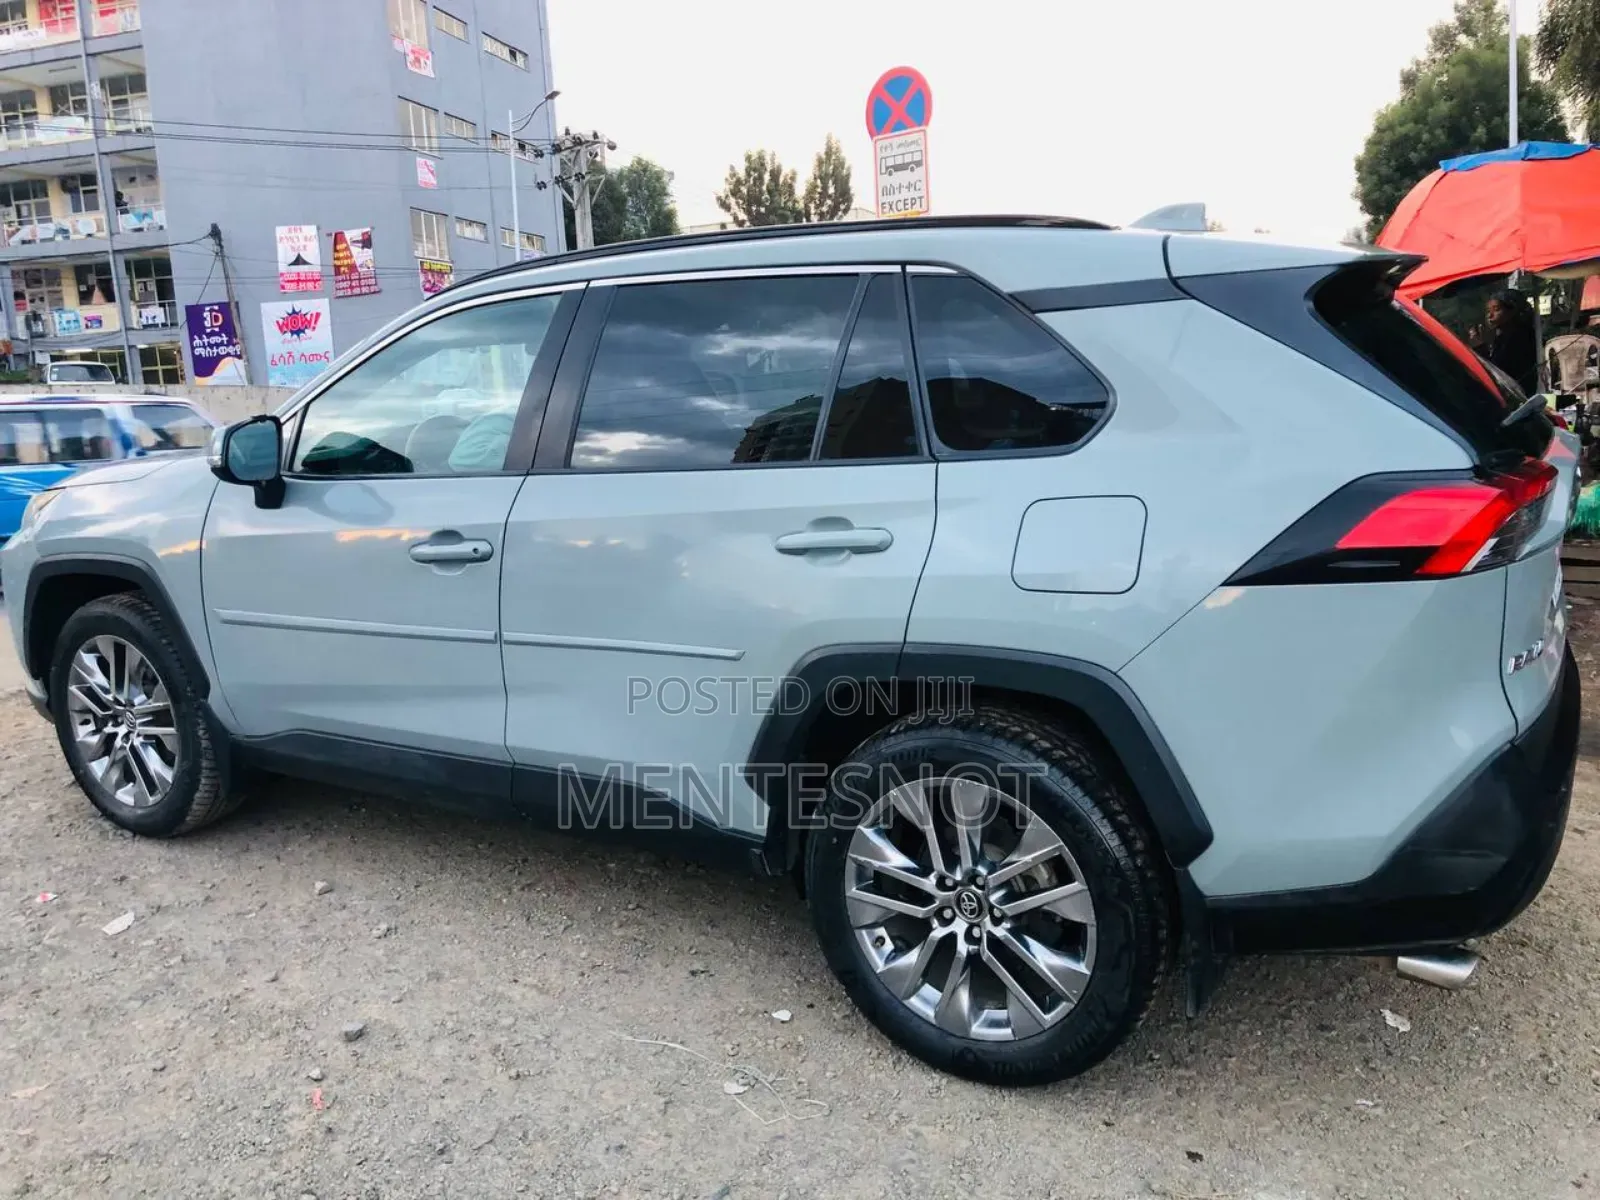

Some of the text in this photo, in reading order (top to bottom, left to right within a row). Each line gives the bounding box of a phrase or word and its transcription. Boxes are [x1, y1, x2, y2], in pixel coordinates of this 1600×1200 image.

[881, 196, 925, 214] EXCEPT
[203, 311, 224, 327] 3D
[275, 311, 322, 334] WOW!
